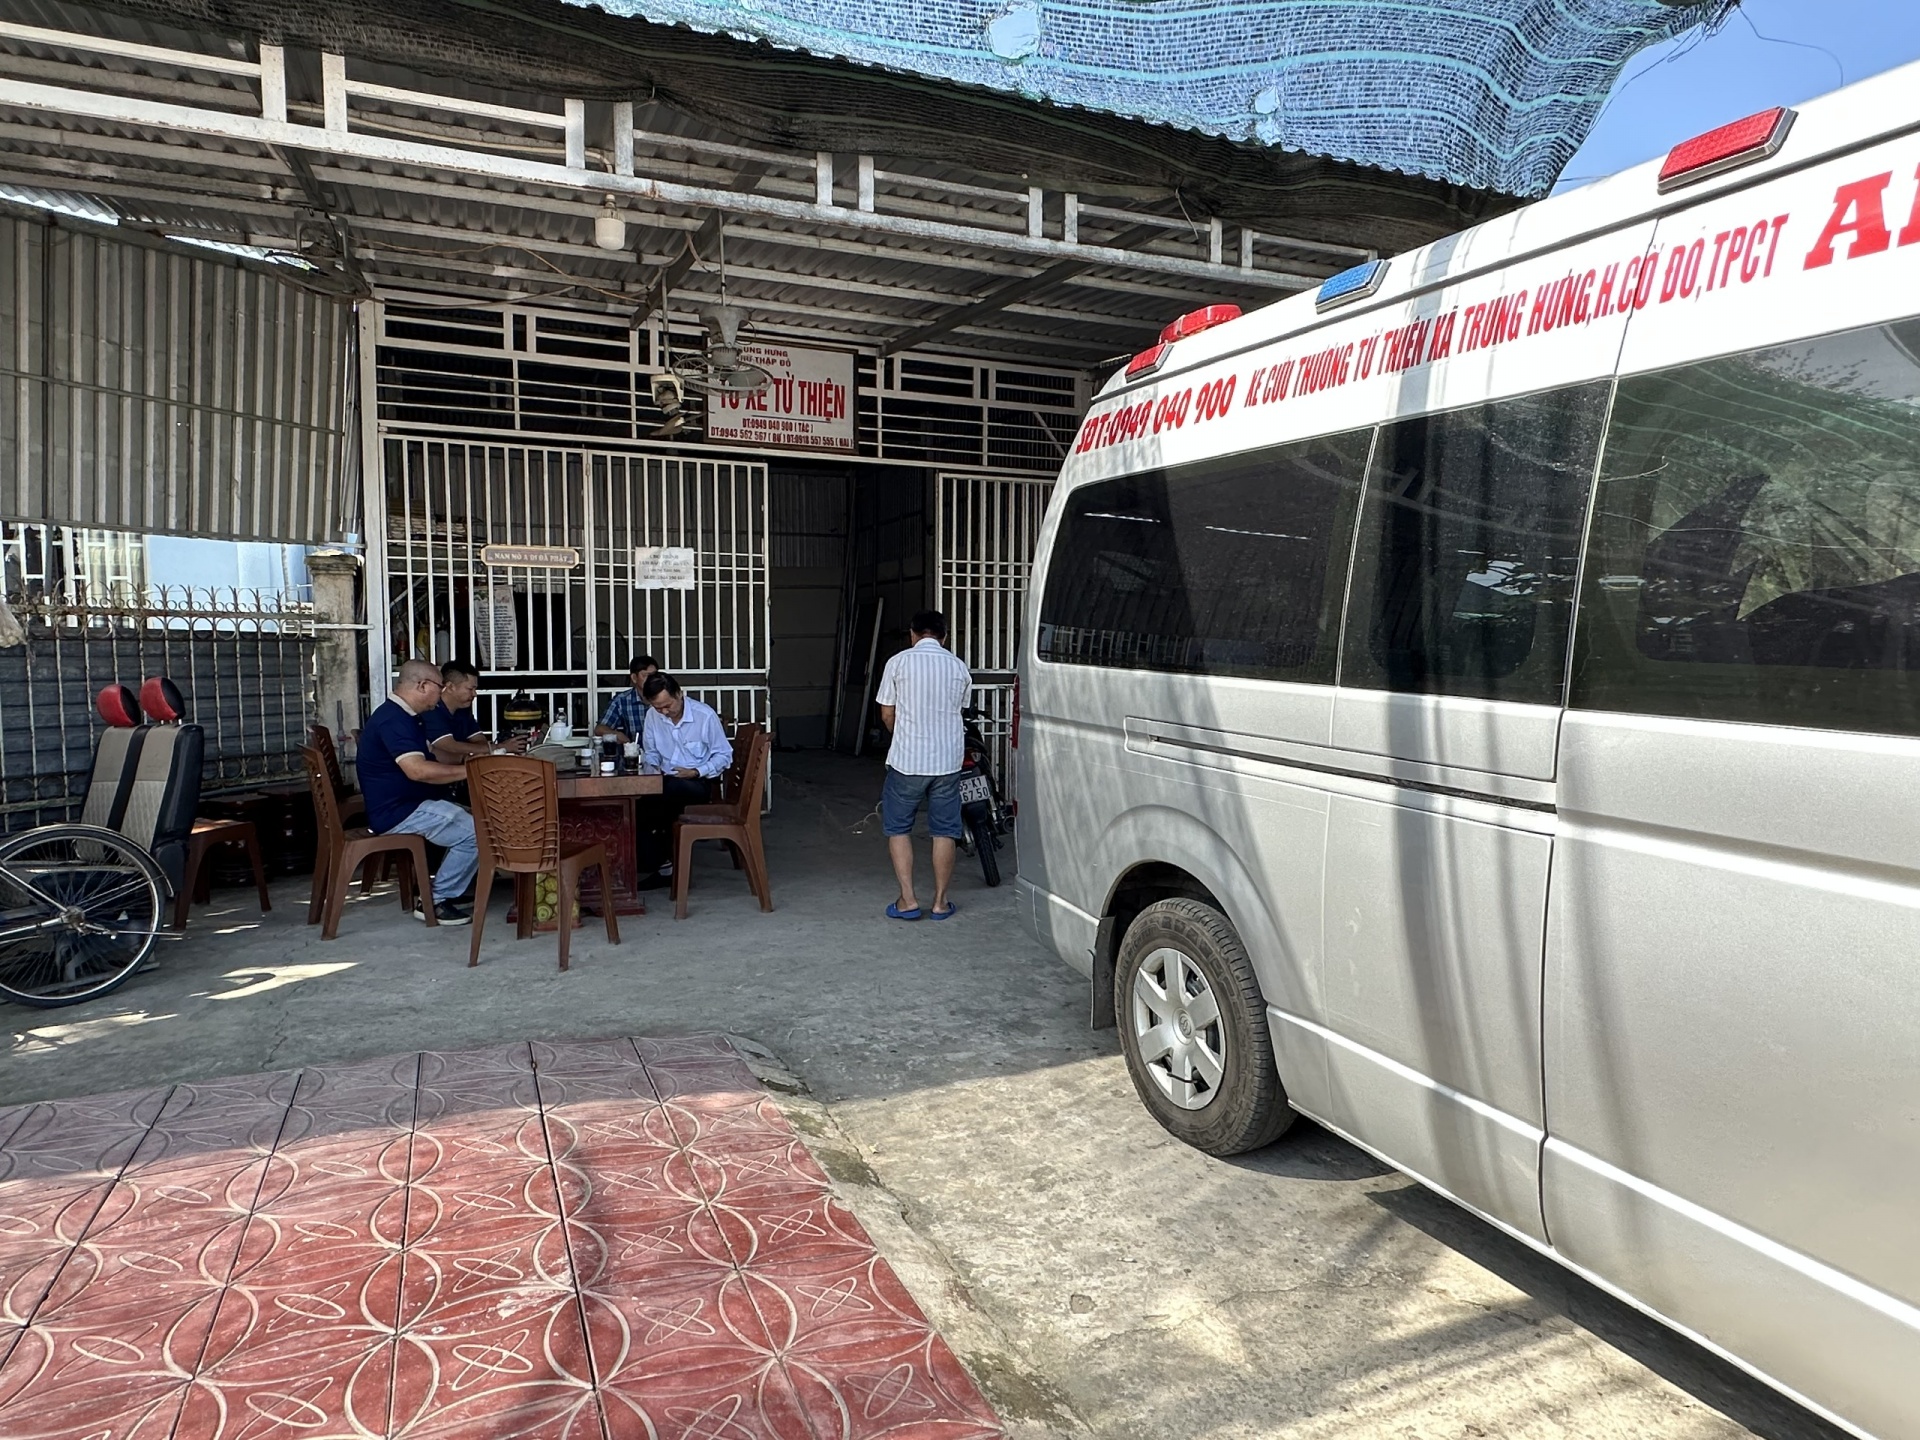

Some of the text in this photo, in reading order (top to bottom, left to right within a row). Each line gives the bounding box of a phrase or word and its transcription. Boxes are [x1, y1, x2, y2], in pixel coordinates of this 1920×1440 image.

[1802, 162, 1919, 271] A
[764, 348, 789, 358] HƯNG
[1243, 367, 1268, 408] XE
[1292, 342, 1354, 398] THƯƠNG
[1352, 328, 1382, 382] TỪ
[1376, 315, 1432, 376] THIỆN
[1426, 305, 1459, 362] XÃ
[1457, 289, 1528, 354] TRUNG
[773, 371, 794, 414] TỪ
[798, 377, 845, 422] THIỆN
[1152, 388, 1193, 435] 040
[1193, 374, 1237, 425] 900
[739, 429, 753, 439] 562
[755, 431, 767, 440] 567
[811, 435, 821, 445] 557
[823, 436, 834, 446] 555
[768, 420, 780, 430] 040
[781, 421, 793, 432] 900
[494, 552, 511, 560] NAM
